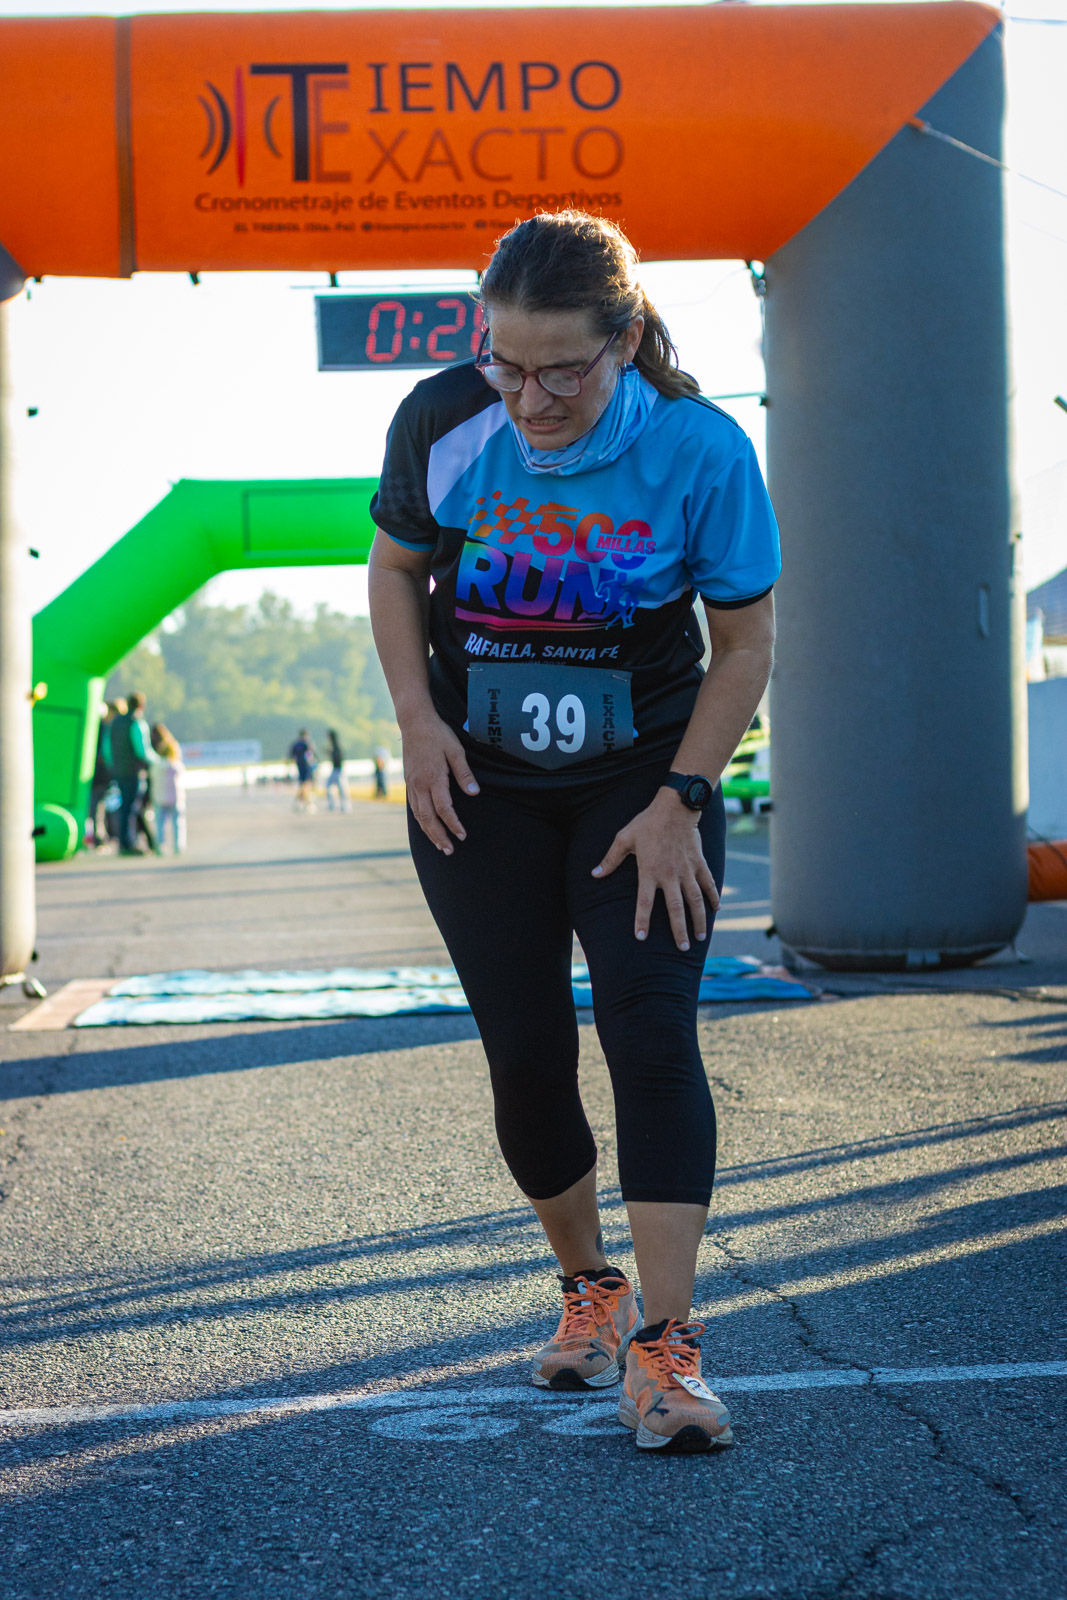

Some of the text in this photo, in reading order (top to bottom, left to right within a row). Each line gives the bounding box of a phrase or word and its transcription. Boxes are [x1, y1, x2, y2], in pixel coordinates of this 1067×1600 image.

[194, 187, 623, 215] Cronometraje de Eventos Deportivos
[596, 533, 657, 555] MILLAS
[455, 540, 618, 621] RUN
[464, 632, 536, 659] RAFAELA,
[541, 645, 596, 661] SANTA
[520, 692, 586, 753] 39
